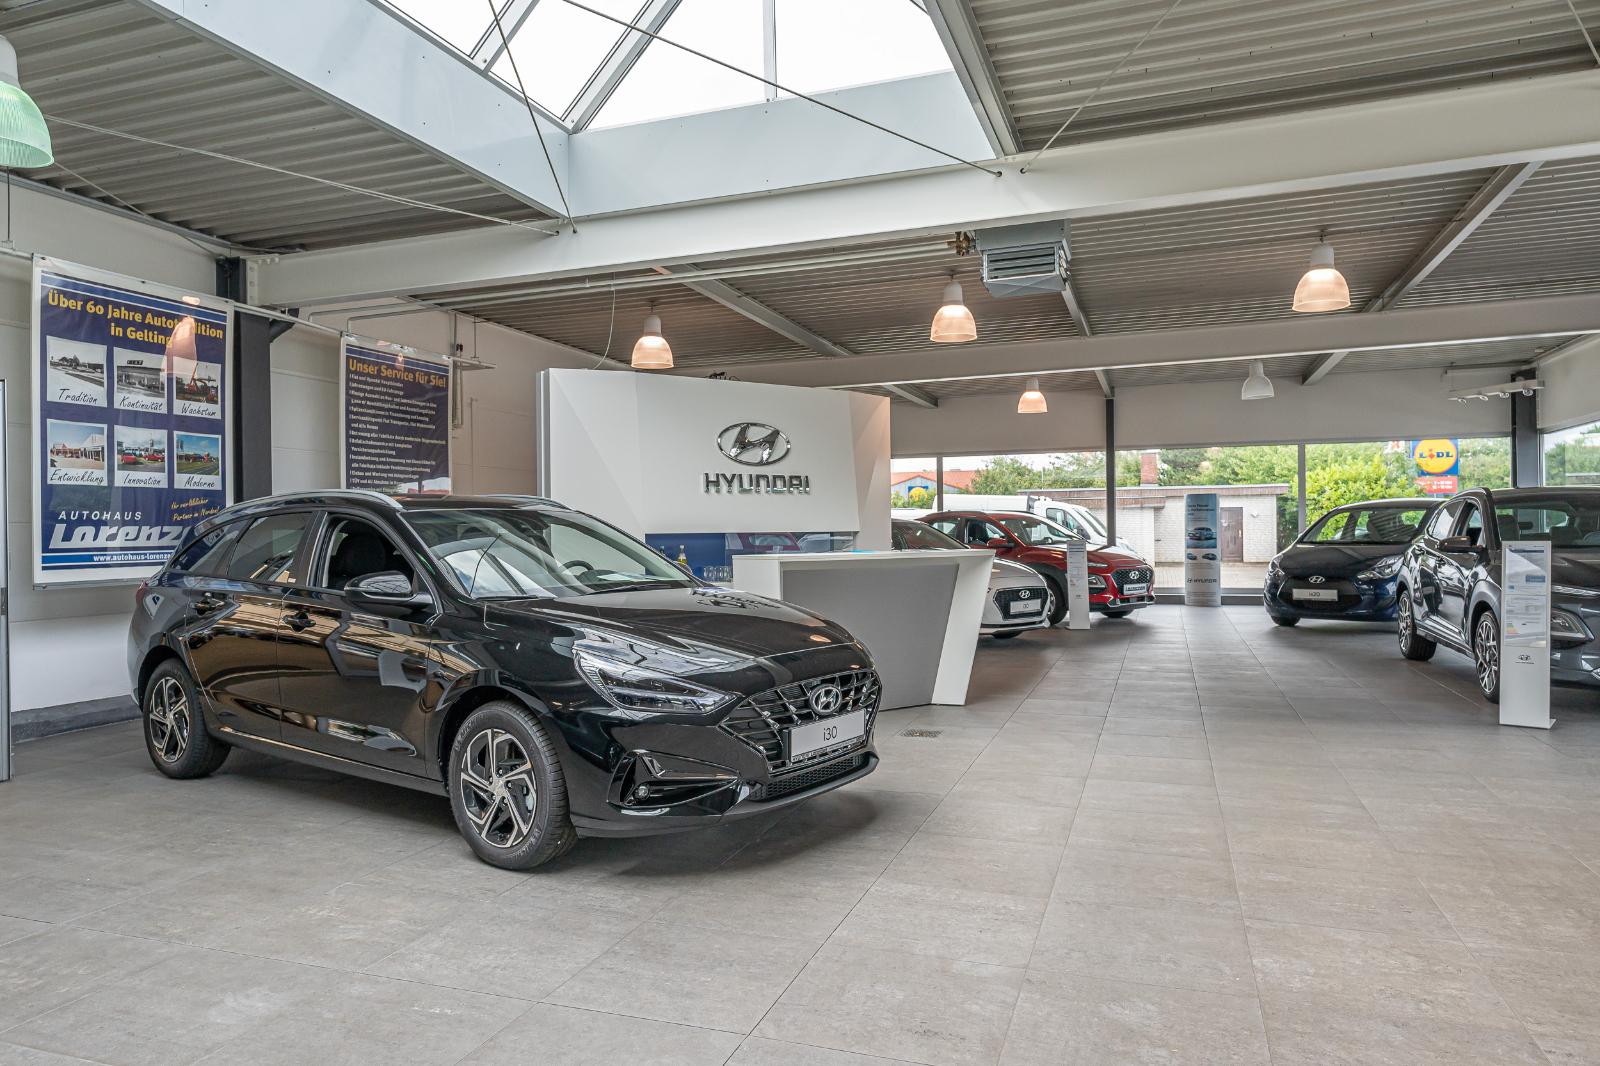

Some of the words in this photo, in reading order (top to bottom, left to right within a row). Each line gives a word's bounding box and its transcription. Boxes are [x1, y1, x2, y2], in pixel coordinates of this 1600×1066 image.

[48, 289, 83, 311] Über
[86, 300, 104, 314] 60
[107, 305, 142, 323] Jahre
[145, 313, 224, 340] Autotdition
[110, 323, 123, 337] in
[349, 358, 379, 374] Unser
[380, 364, 414, 381] Service
[415, 372, 428, 384] für
[430, 374, 446, 387] Sie!
[58, 388, 98, 404] Tradition
[120, 396, 162, 411] Kontinuität
[182, 402, 216, 417] Wachstum
[50, 469, 104, 484] Entwicklung
[124, 472, 161, 486] Innovation
[184, 476, 216, 488] Moderne
[704, 472, 810, 494] HYUNDAI
[58, 510, 142, 521] AUTOHAUS
[49, 523, 191, 548] Lorenz
[823, 725, 838, 741] i30
